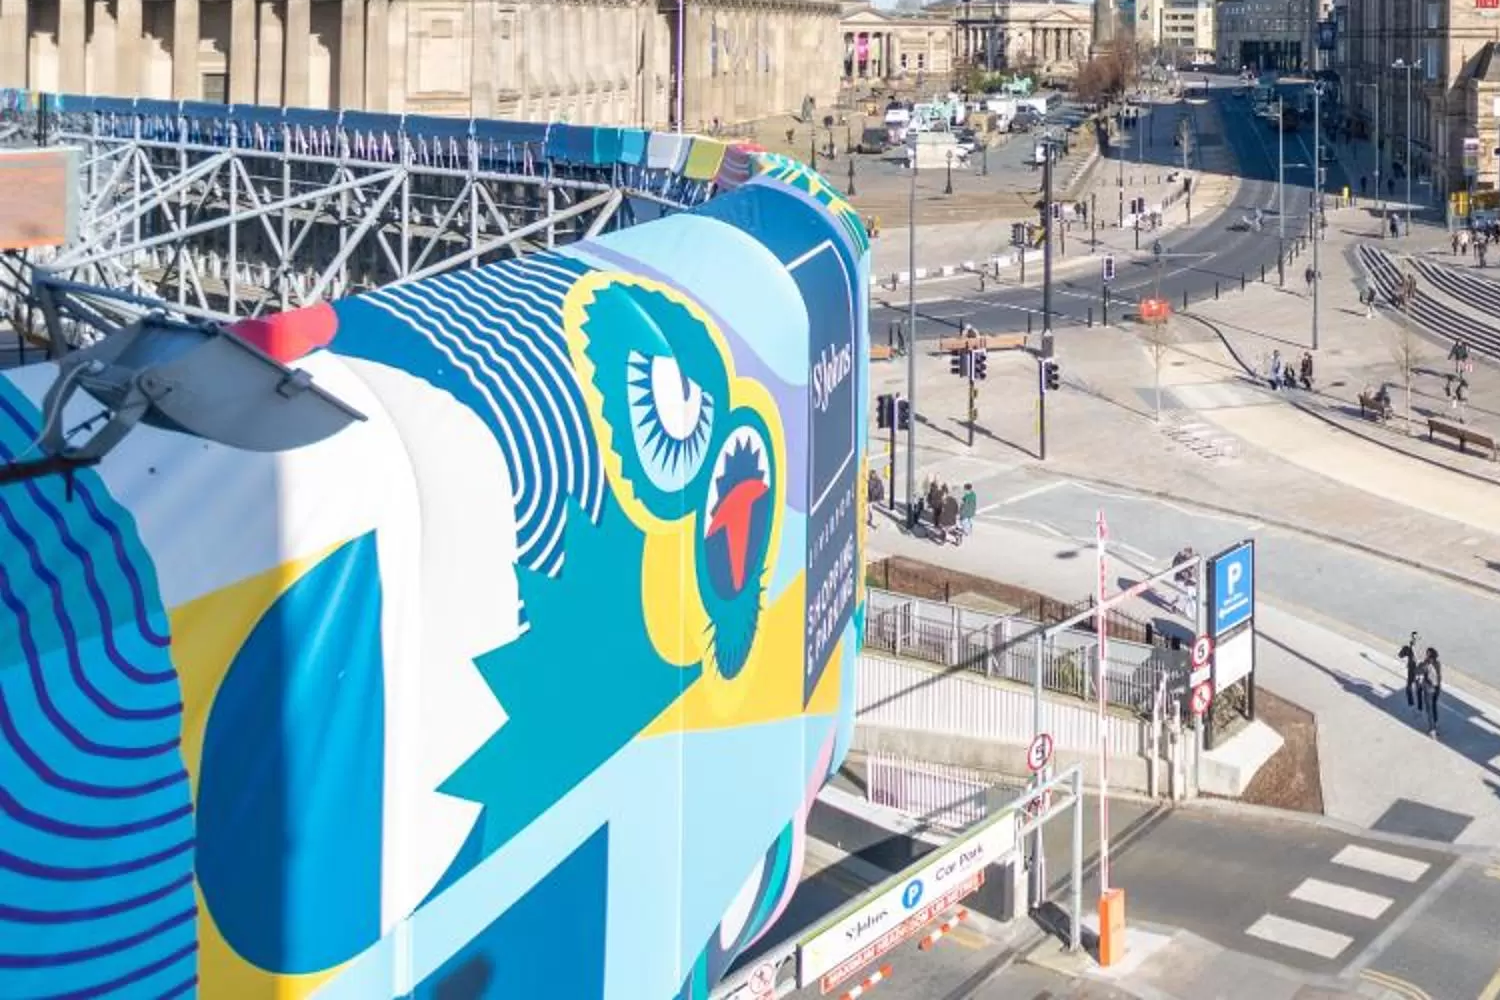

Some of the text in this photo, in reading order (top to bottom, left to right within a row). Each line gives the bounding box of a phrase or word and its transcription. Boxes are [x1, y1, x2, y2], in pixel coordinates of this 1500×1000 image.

[808, 532, 853, 635] SHOPPING
[1227, 561, 1242, 595] P
[815, 567, 853, 661] PARKING
[935, 861, 957, 881] Car
[959, 842, 984, 866] Park
